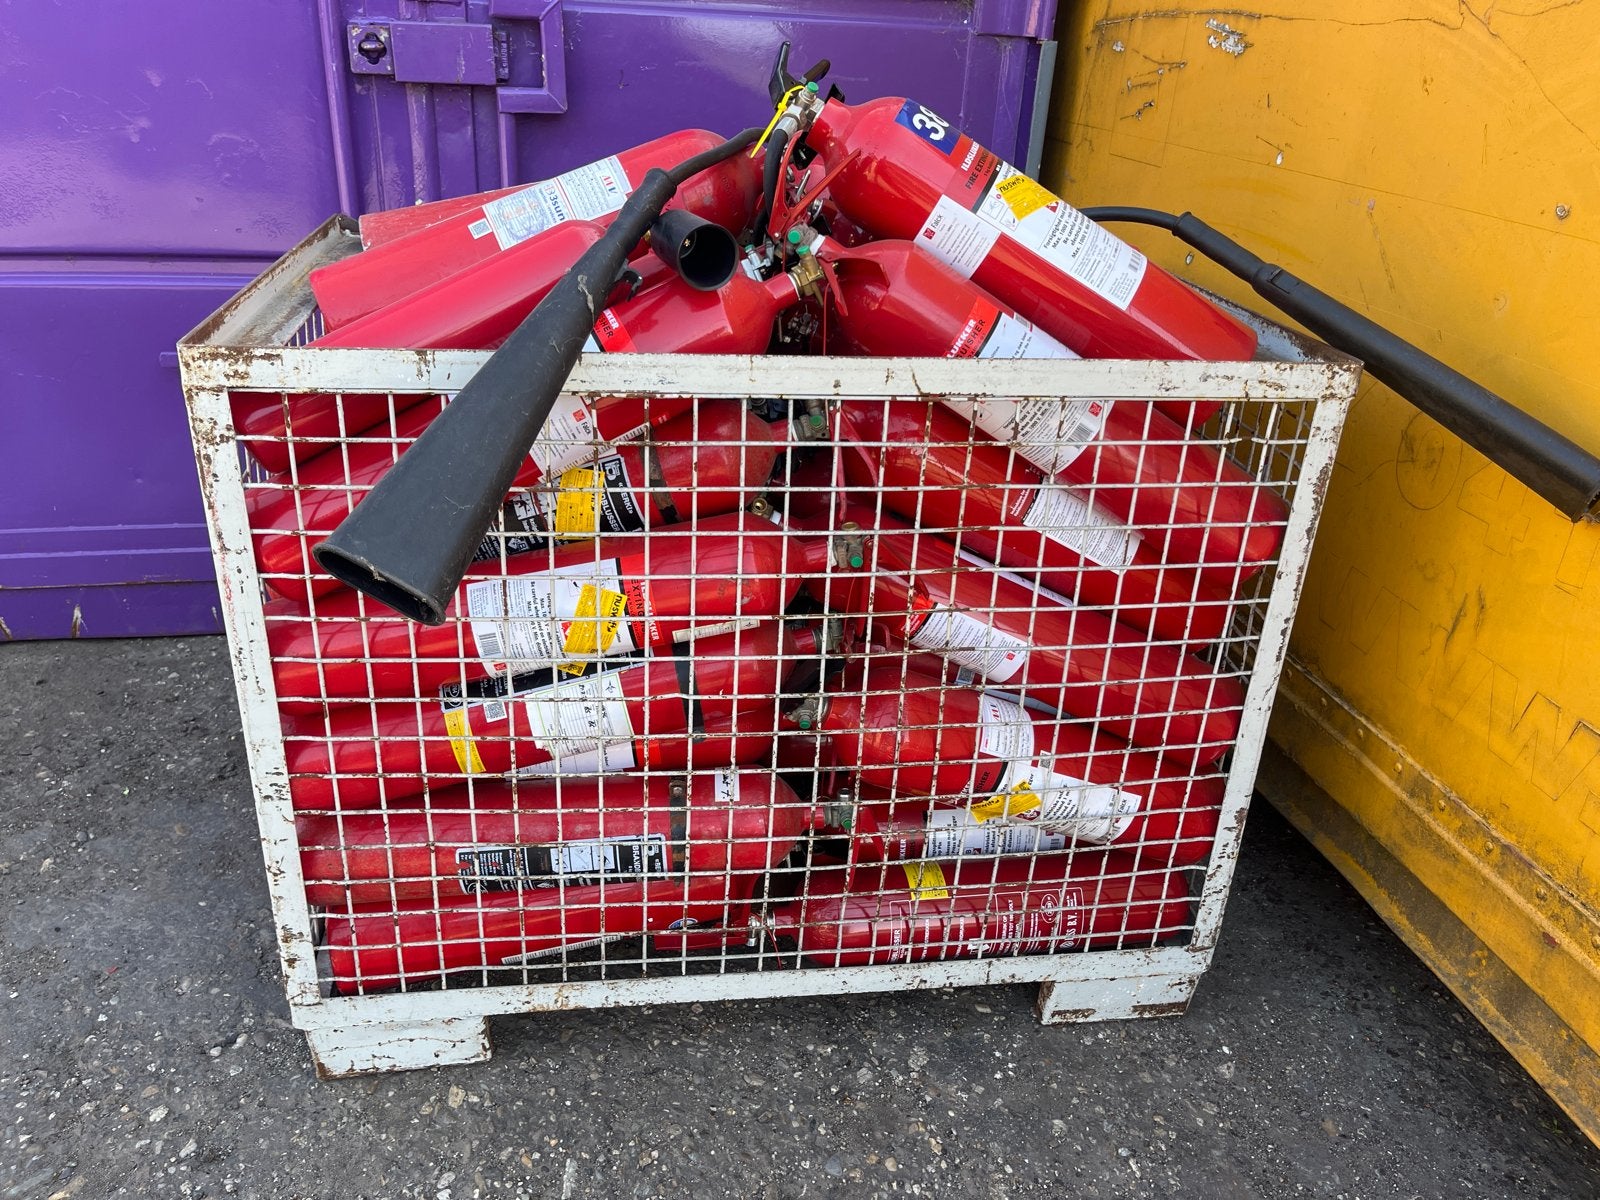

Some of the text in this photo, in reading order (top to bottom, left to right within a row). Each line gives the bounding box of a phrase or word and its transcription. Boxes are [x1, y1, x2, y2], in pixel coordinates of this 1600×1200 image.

[964, 171, 978, 189] FIRE
[548, 194, 566, 221] 3sun
[930, 212, 943, 229] Falck
[1064, 220, 1077, 237] careful
[1051, 234, 1062, 249] Max.
[1062, 236, 1069, 244] Be
[1070, 244, 1081, 258] Max.
[946, 317, 976, 358] LUKKER
[1028, 411, 1038, 422] used
[580, 420, 592, 435] Falck
[530, 588, 538, 604] careful
